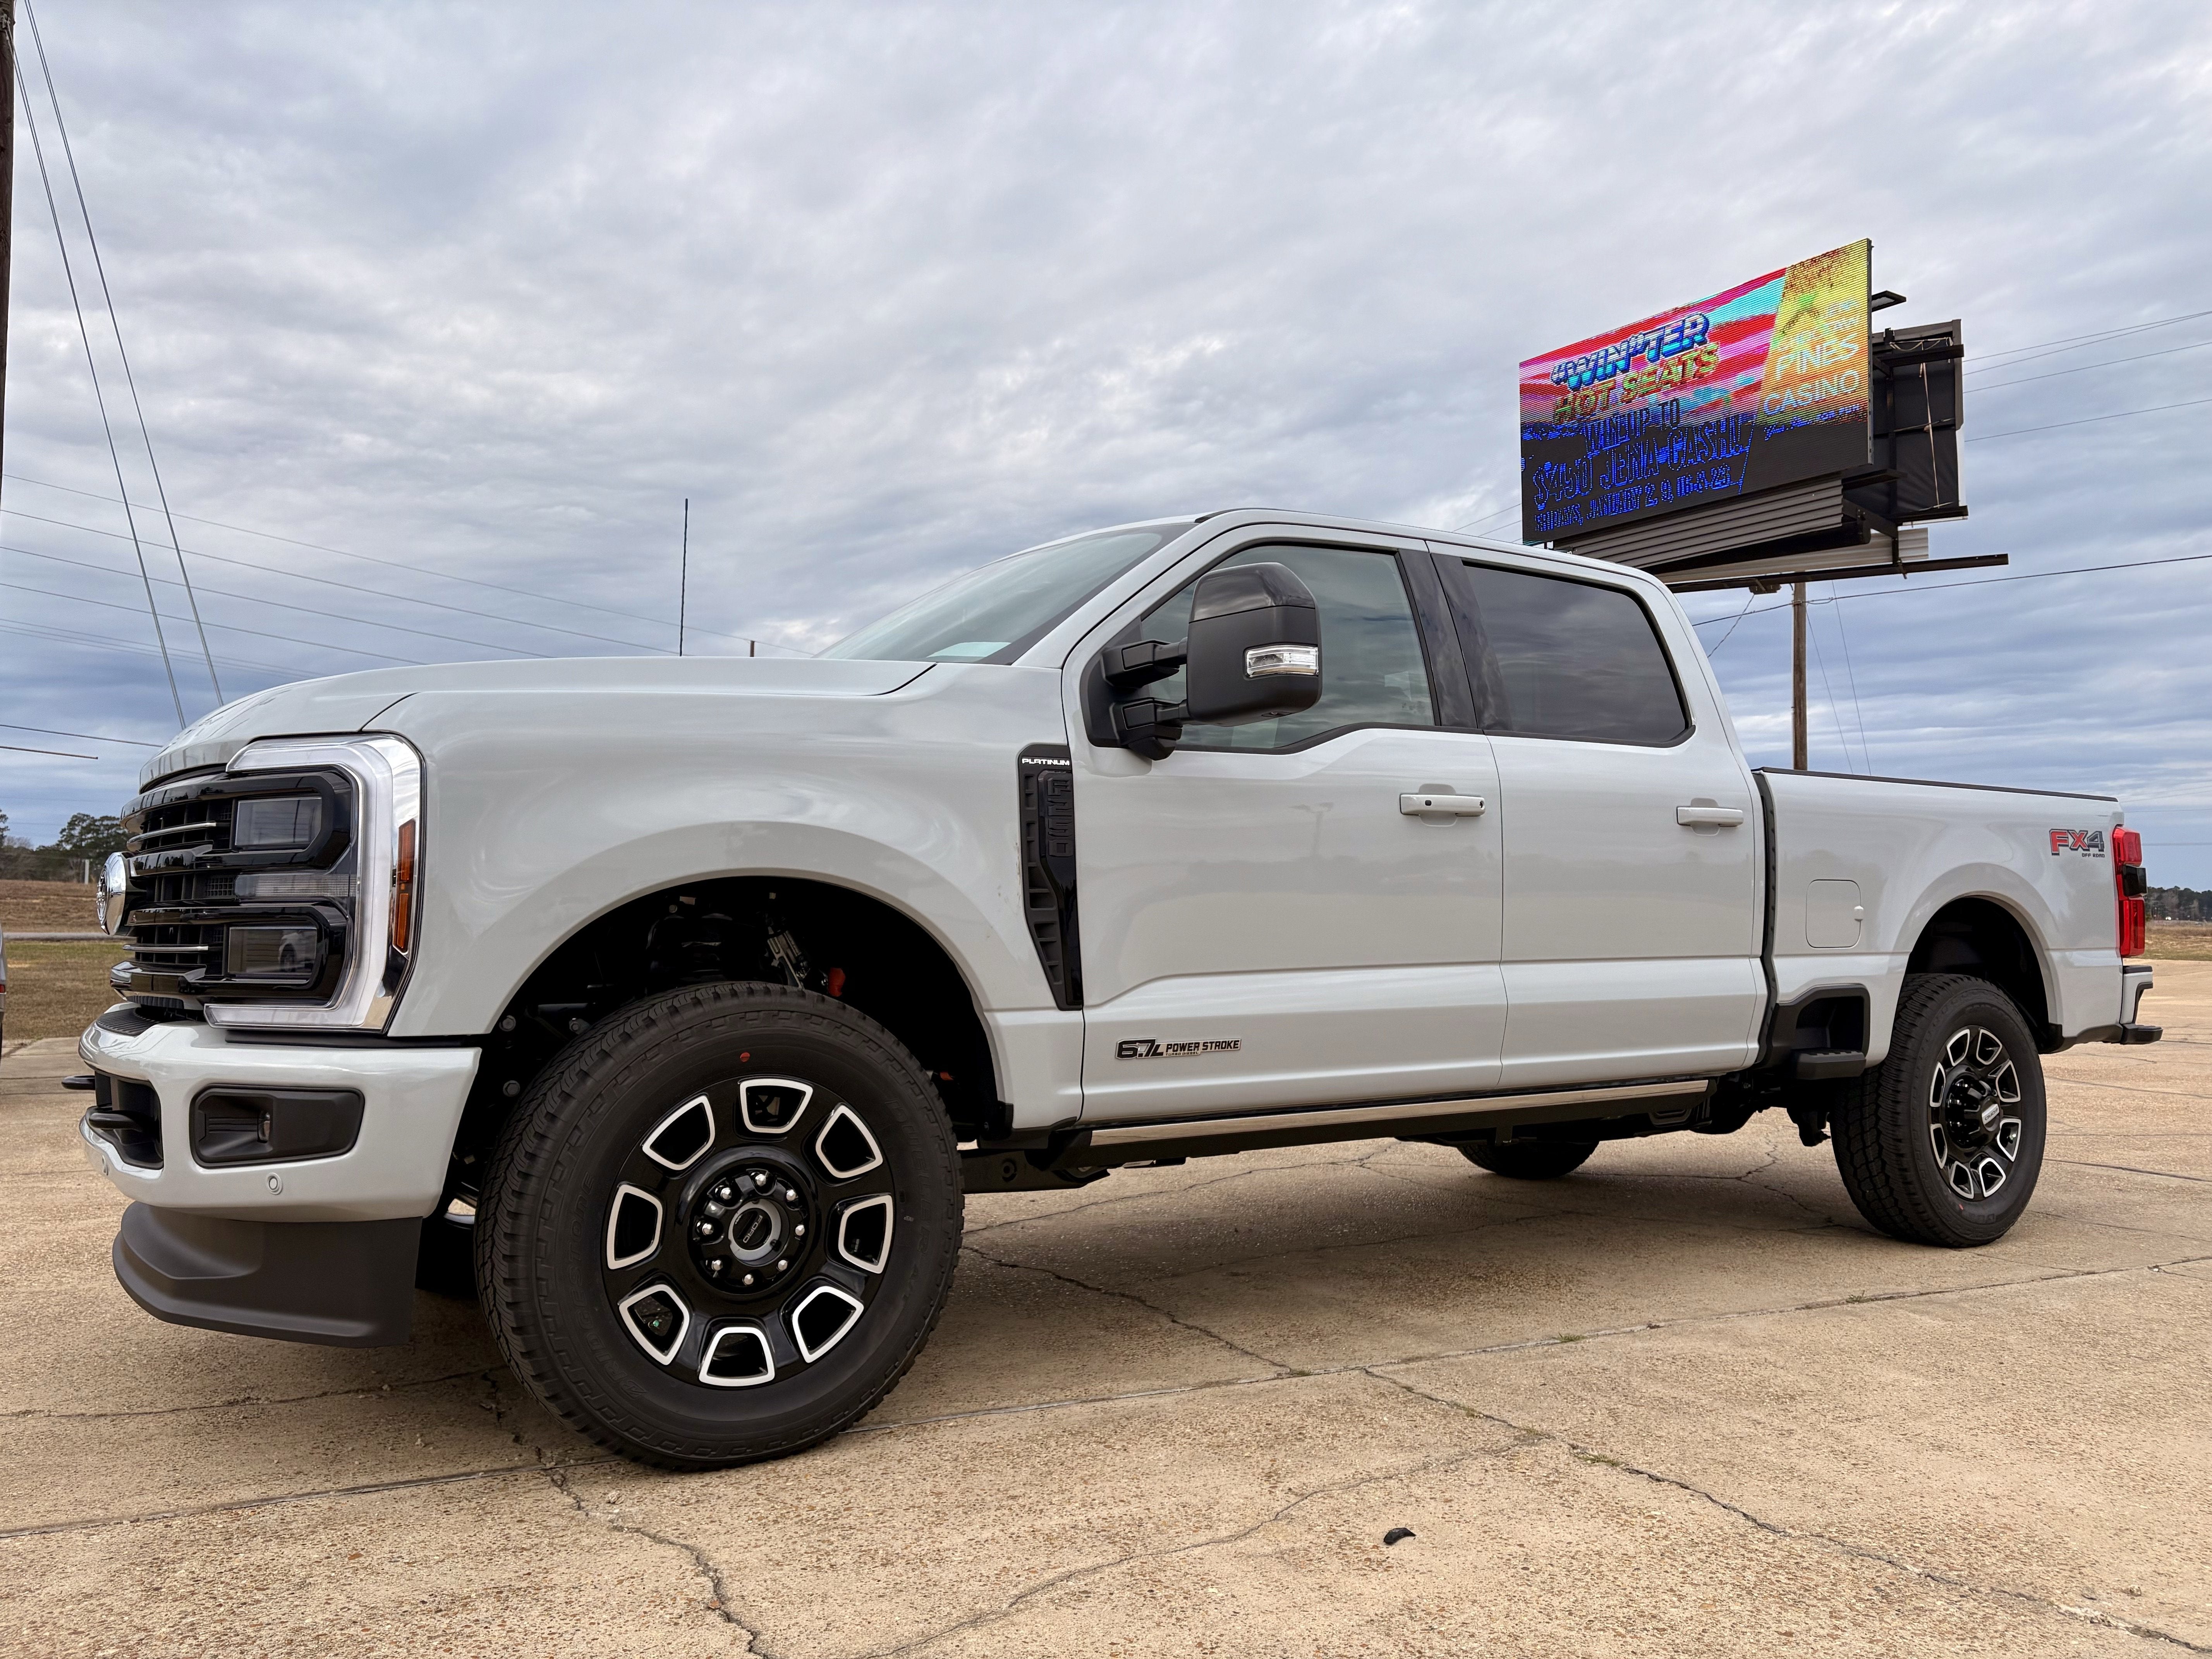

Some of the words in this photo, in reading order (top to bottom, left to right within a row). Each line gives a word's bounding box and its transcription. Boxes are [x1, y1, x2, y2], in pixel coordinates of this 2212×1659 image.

[1774, 332, 1859, 380] PINES
[1554, 380, 1616, 425] HOT
[1621, 343, 1719, 402] SEATS
[1763, 369, 1860, 416] CASINO
[1659, 398, 1679, 431] TO
[1600, 438, 1659, 490] JENA
[1022, 758, 1070, 766] PLATINUM
[2049, 829, 2105, 856] FX4
[1116, 1038, 1164, 1059] 6.7L
[1166, 1042, 1200, 1053] POWER
[1202, 1040, 1240, 1051] STROKE
[743, 1215, 763, 1243] FORD
[568, 1170, 647, 1399] BRIDGESTONE
